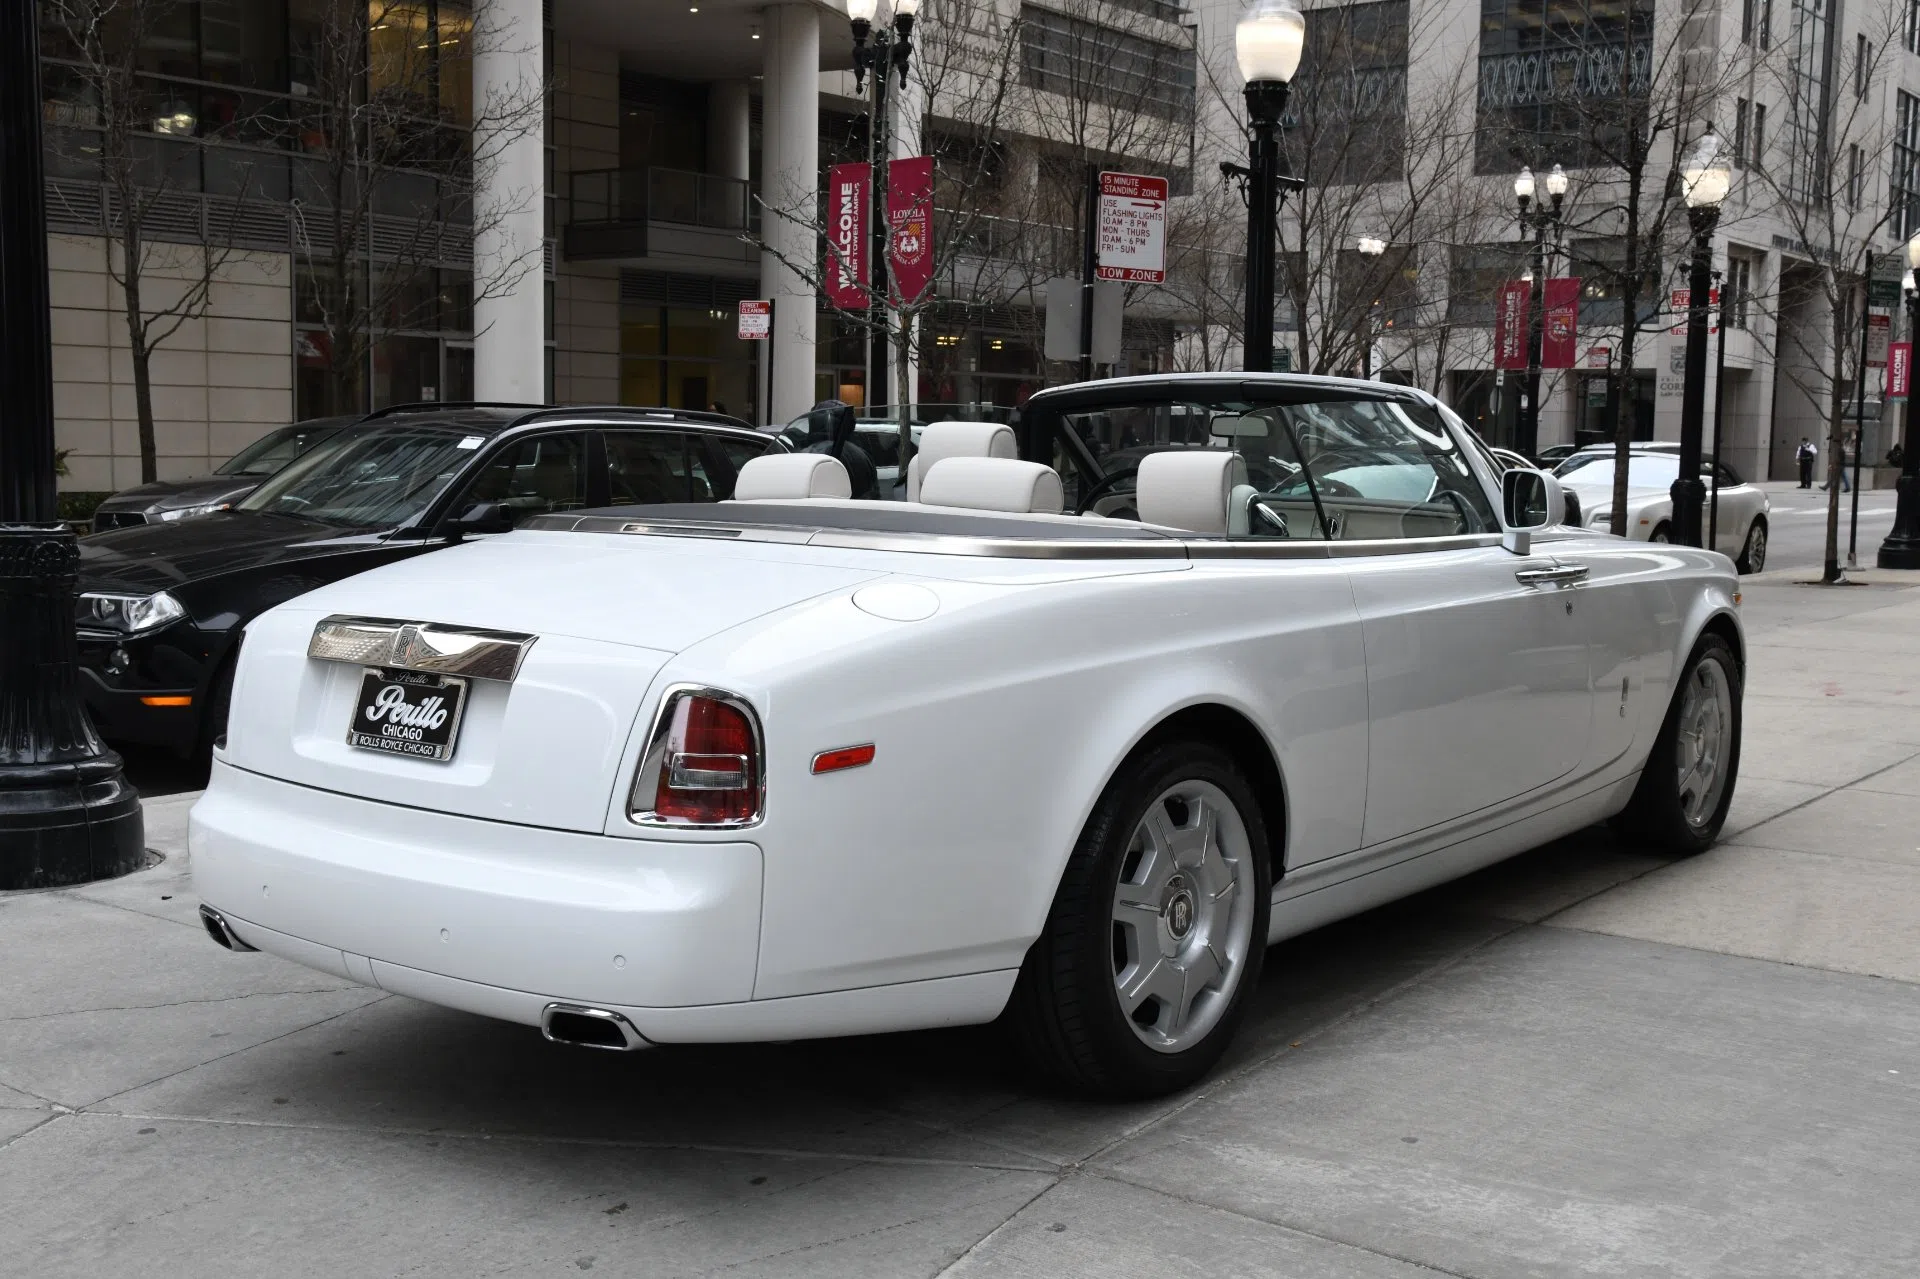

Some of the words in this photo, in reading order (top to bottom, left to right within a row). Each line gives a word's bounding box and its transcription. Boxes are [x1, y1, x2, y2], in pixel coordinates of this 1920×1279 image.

[1104, 175, 1111, 183] 15
[1114, 177, 1139, 186] MINUTE
[1104, 185, 1138, 195] STANDING
[1142, 188, 1159, 197] ZONE
[1103, 199, 1117, 207] USE
[893, 208, 925, 219] LOYOLA
[1103, 208, 1137, 218] FLASHING
[1139, 212, 1162, 221] LIGHTS
[1103, 217, 1111, 225] 10
[1112, 218, 1122, 226] AM
[1137, 220, 1148, 228] PM
[838, 182, 852, 290] WELCOME
[1103, 226, 1118, 234] MON
[1127, 228, 1150, 237] THURS
[1111, 235, 1121, 243] AM
[1129, 237, 1134, 245] 6
[1136, 238, 1146, 246] PM
[1102, 244, 1114, 252] FRI
[1120, 246, 1135, 254] SUN
[1102, 267, 1124, 278] TOW
[1129, 270, 1158, 282] ZONE
[1893, 348, 1903, 393] WELCOME
[396, 671, 429, 684] Perillo
[366, 685, 448, 730] Perillo
[382, 723, 423, 741] CHICAGO
[360, 735, 380, 748] ROLLS
[380, 739, 402, 751] ROYCE
[403, 743, 434, 756] CHICAGO
